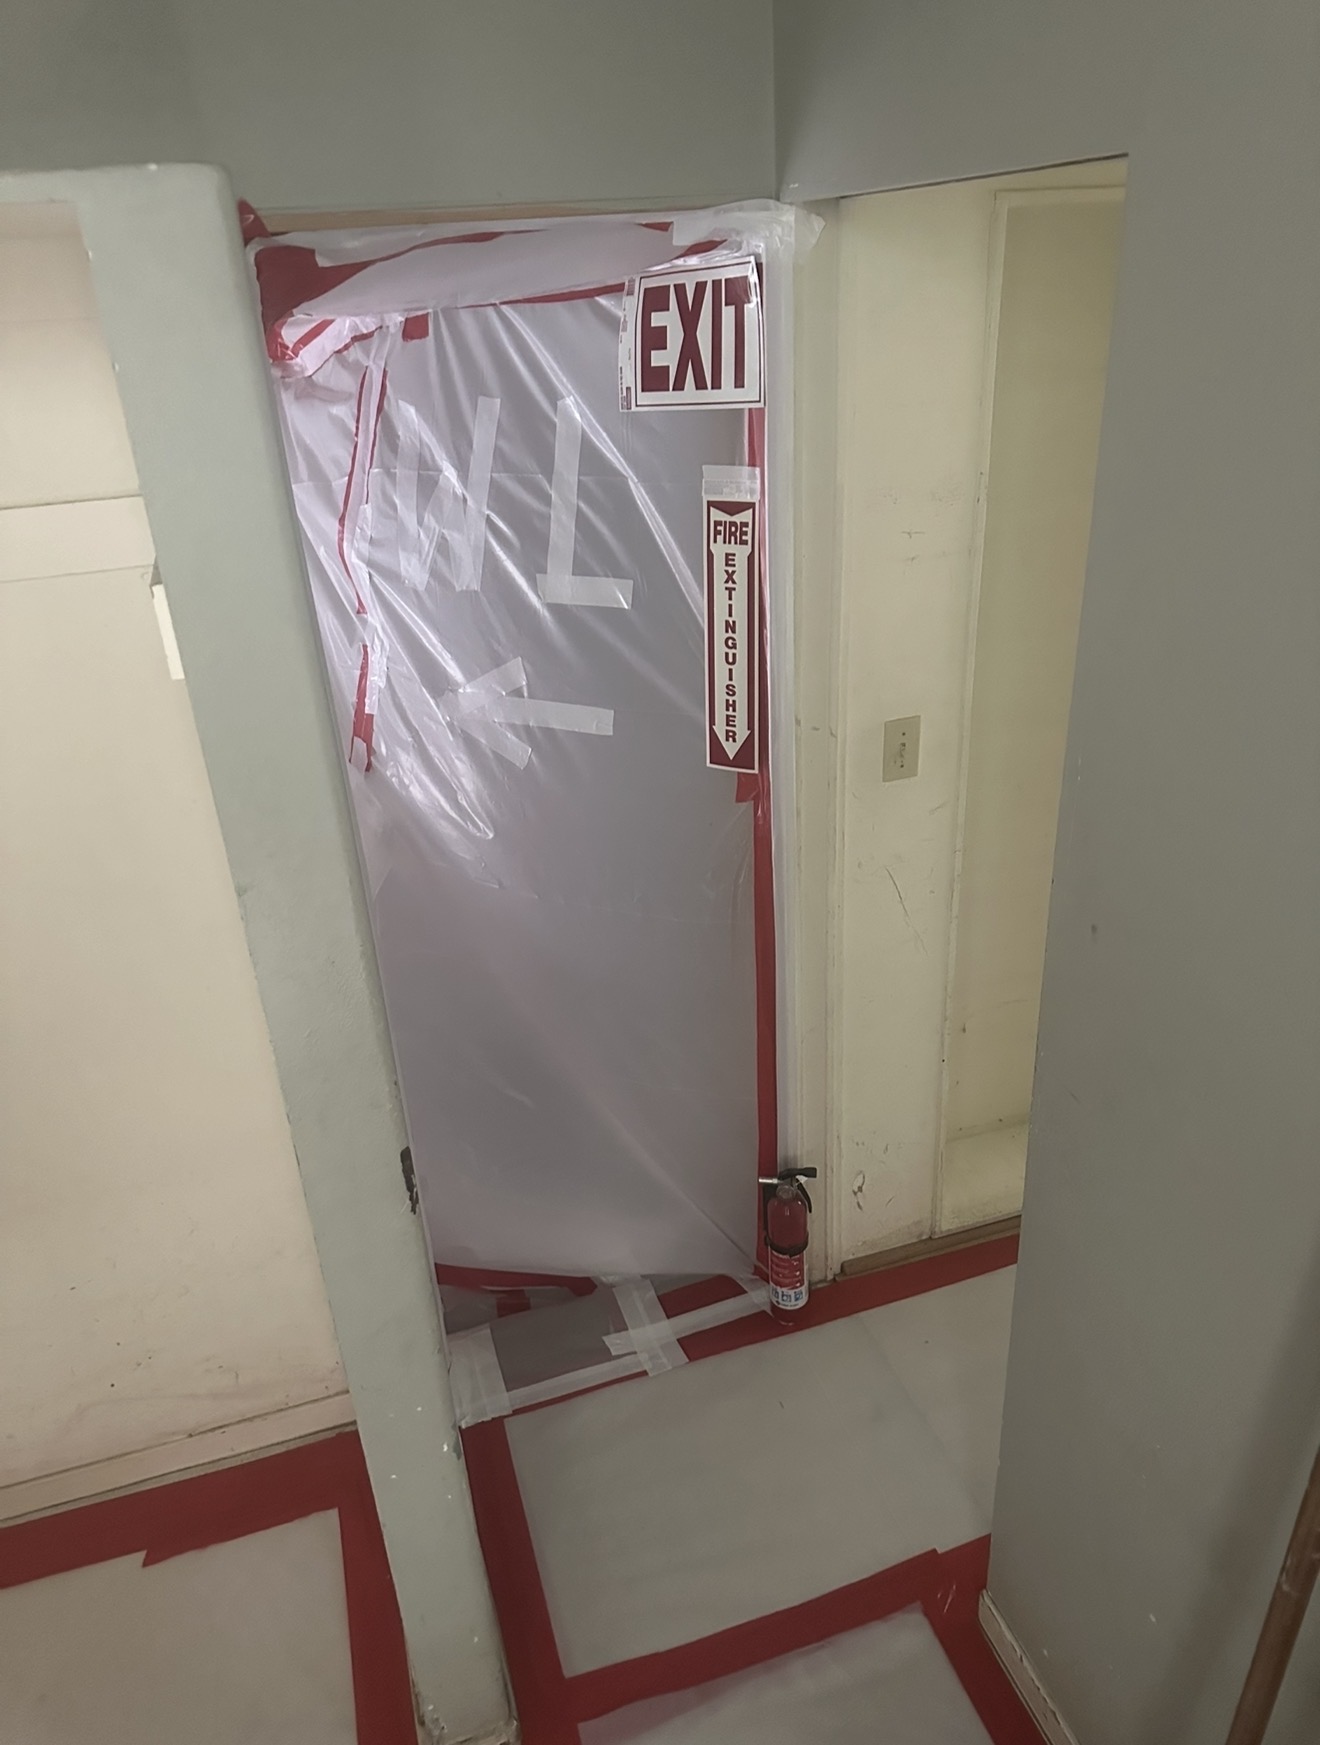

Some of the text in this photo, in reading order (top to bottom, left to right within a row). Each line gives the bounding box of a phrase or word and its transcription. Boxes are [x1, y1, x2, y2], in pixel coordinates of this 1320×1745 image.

[641, 275, 751, 393] EXIT
[713, 520, 749, 546] FIRE
[723, 552, 738, 743] EXTINGUISHER
